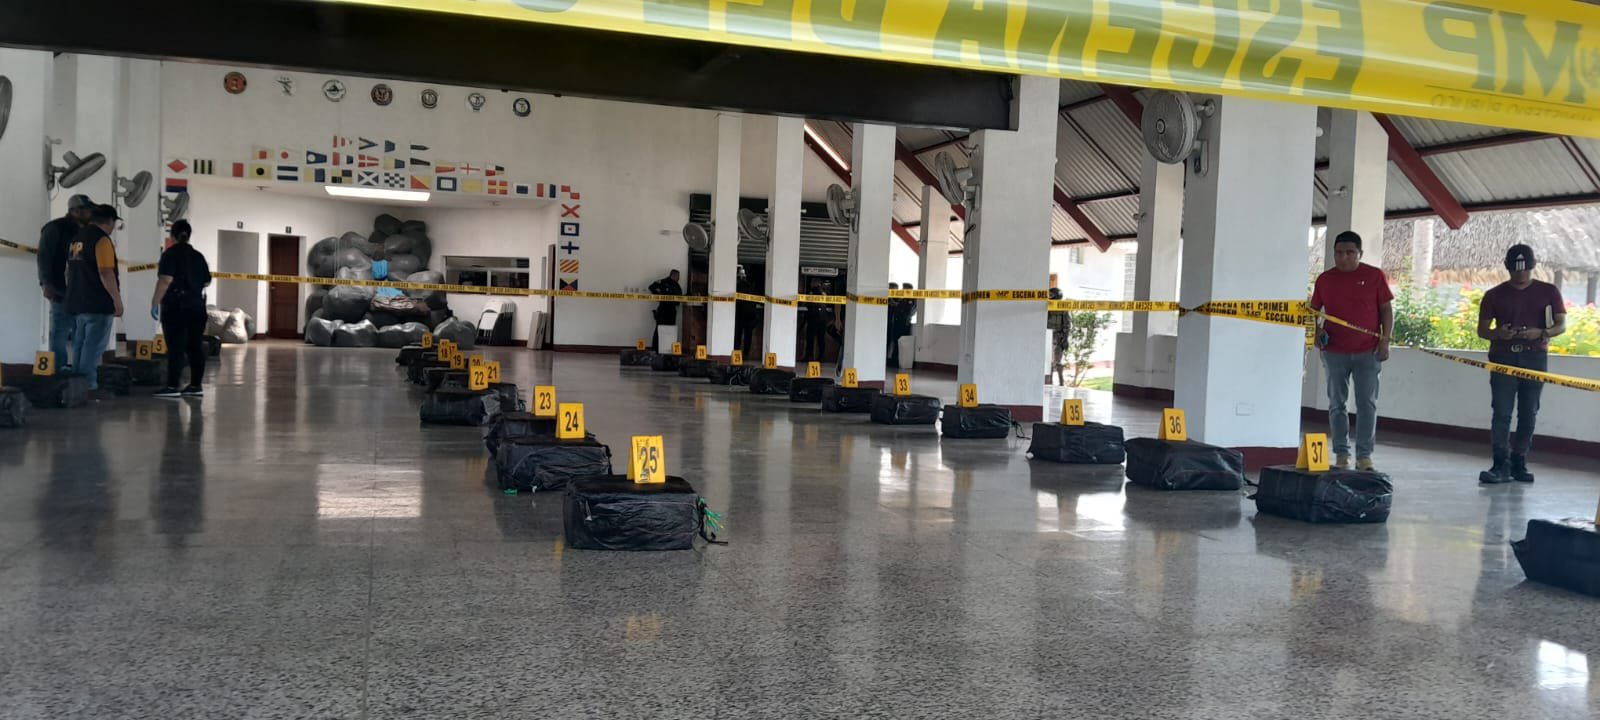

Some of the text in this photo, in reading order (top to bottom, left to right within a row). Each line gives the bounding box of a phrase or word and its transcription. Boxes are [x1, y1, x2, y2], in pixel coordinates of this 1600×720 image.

[70, 242, 83, 255] MP
[1012, 290, 1035, 299] ESCENA
[1258, 302, 1289, 312] CRIMEN
[1265, 312, 1294, 324] ESCENA
[140, 345, 148, 356] 6
[156, 339, 162, 351] 5
[38, 356, 48, 370] 8
[454, 355, 461, 366] 19
[488, 366, 497, 379] 21
[811, 366, 819, 377] 31
[475, 371, 484, 386] 22
[848, 373, 855, 384] 32
[899, 379, 908, 391] 33
[540, 392, 551, 410] 23
[965, 389, 975, 402] 34
[1070, 405, 1080, 421] 35
[565, 411, 578, 432] 24
[1169, 416, 1181, 434] 36
[1312, 441, 1322, 464] 37
[640, 446, 657, 473] 25
